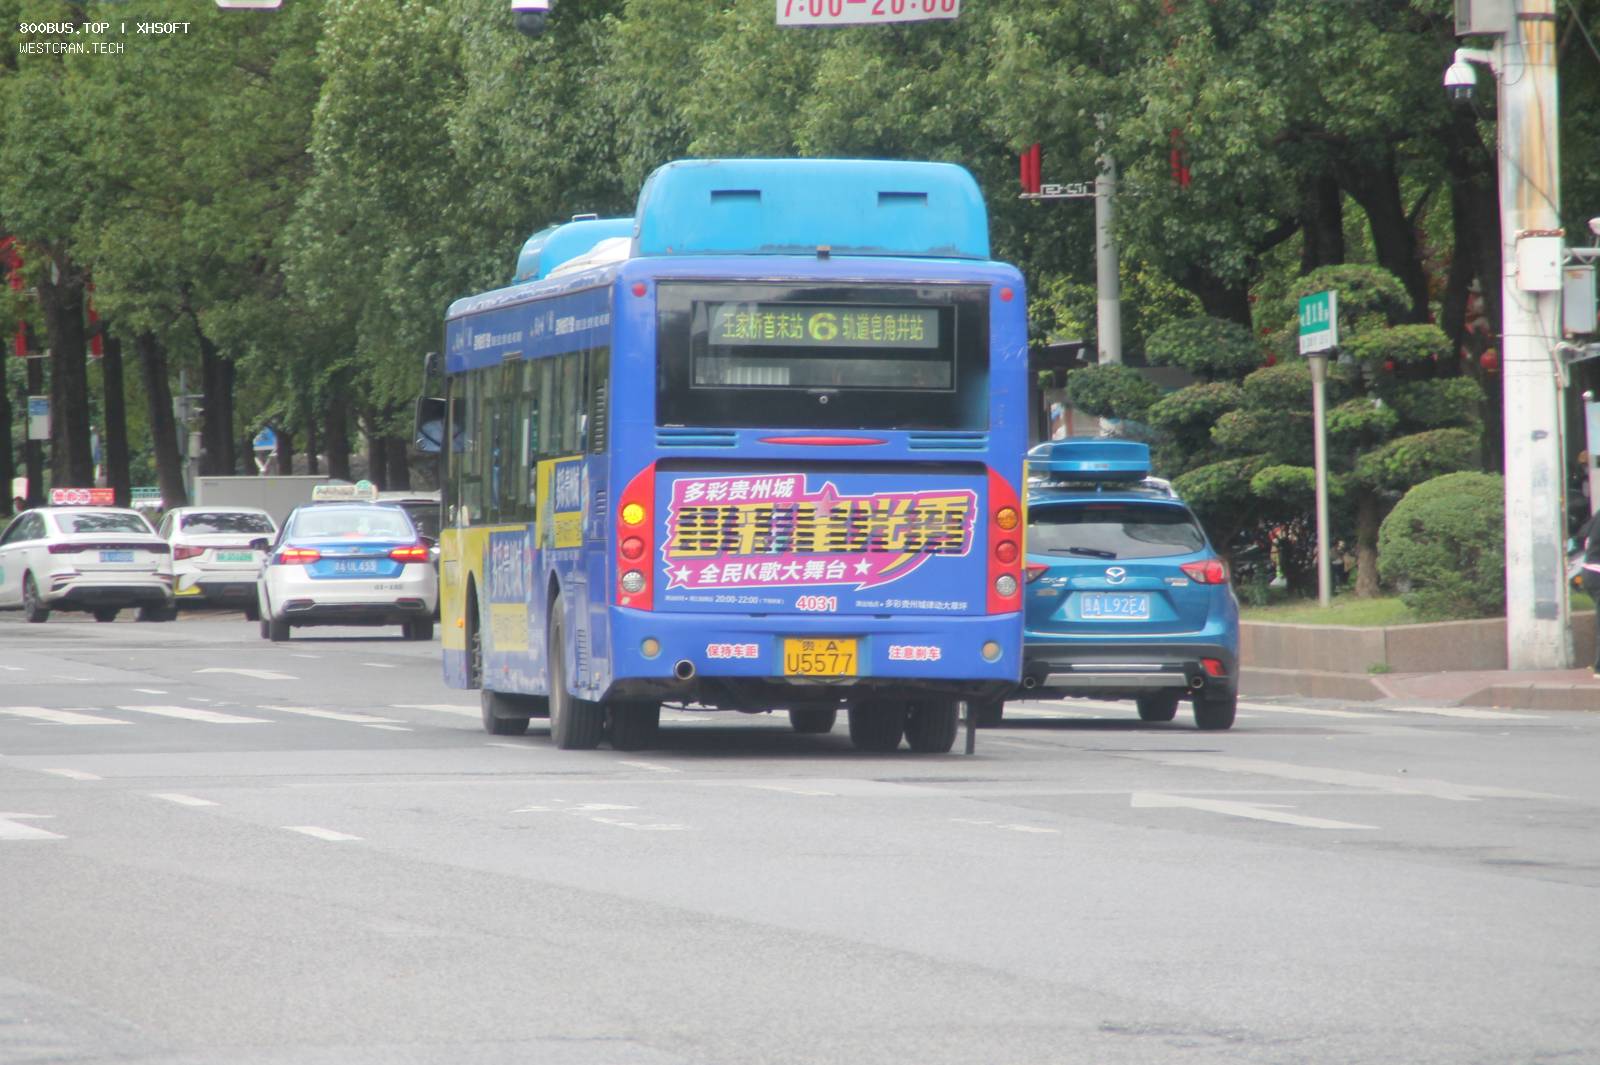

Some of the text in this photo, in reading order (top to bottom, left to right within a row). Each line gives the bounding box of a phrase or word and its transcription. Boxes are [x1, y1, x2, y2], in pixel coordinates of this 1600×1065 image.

[722, 312, 924, 342] 王家桥首末站 6 轨道皂角井站
[683, 477, 796, 502] 多彩贵州城
[698, 559, 848, 585] 全民K歌大舞台
[795, 596, 837, 611] 4031
[707, 643, 759, 659] 保持车距
[888, 645, 941, 661] 注意刹车
[786, 653, 854, 673] U5577
